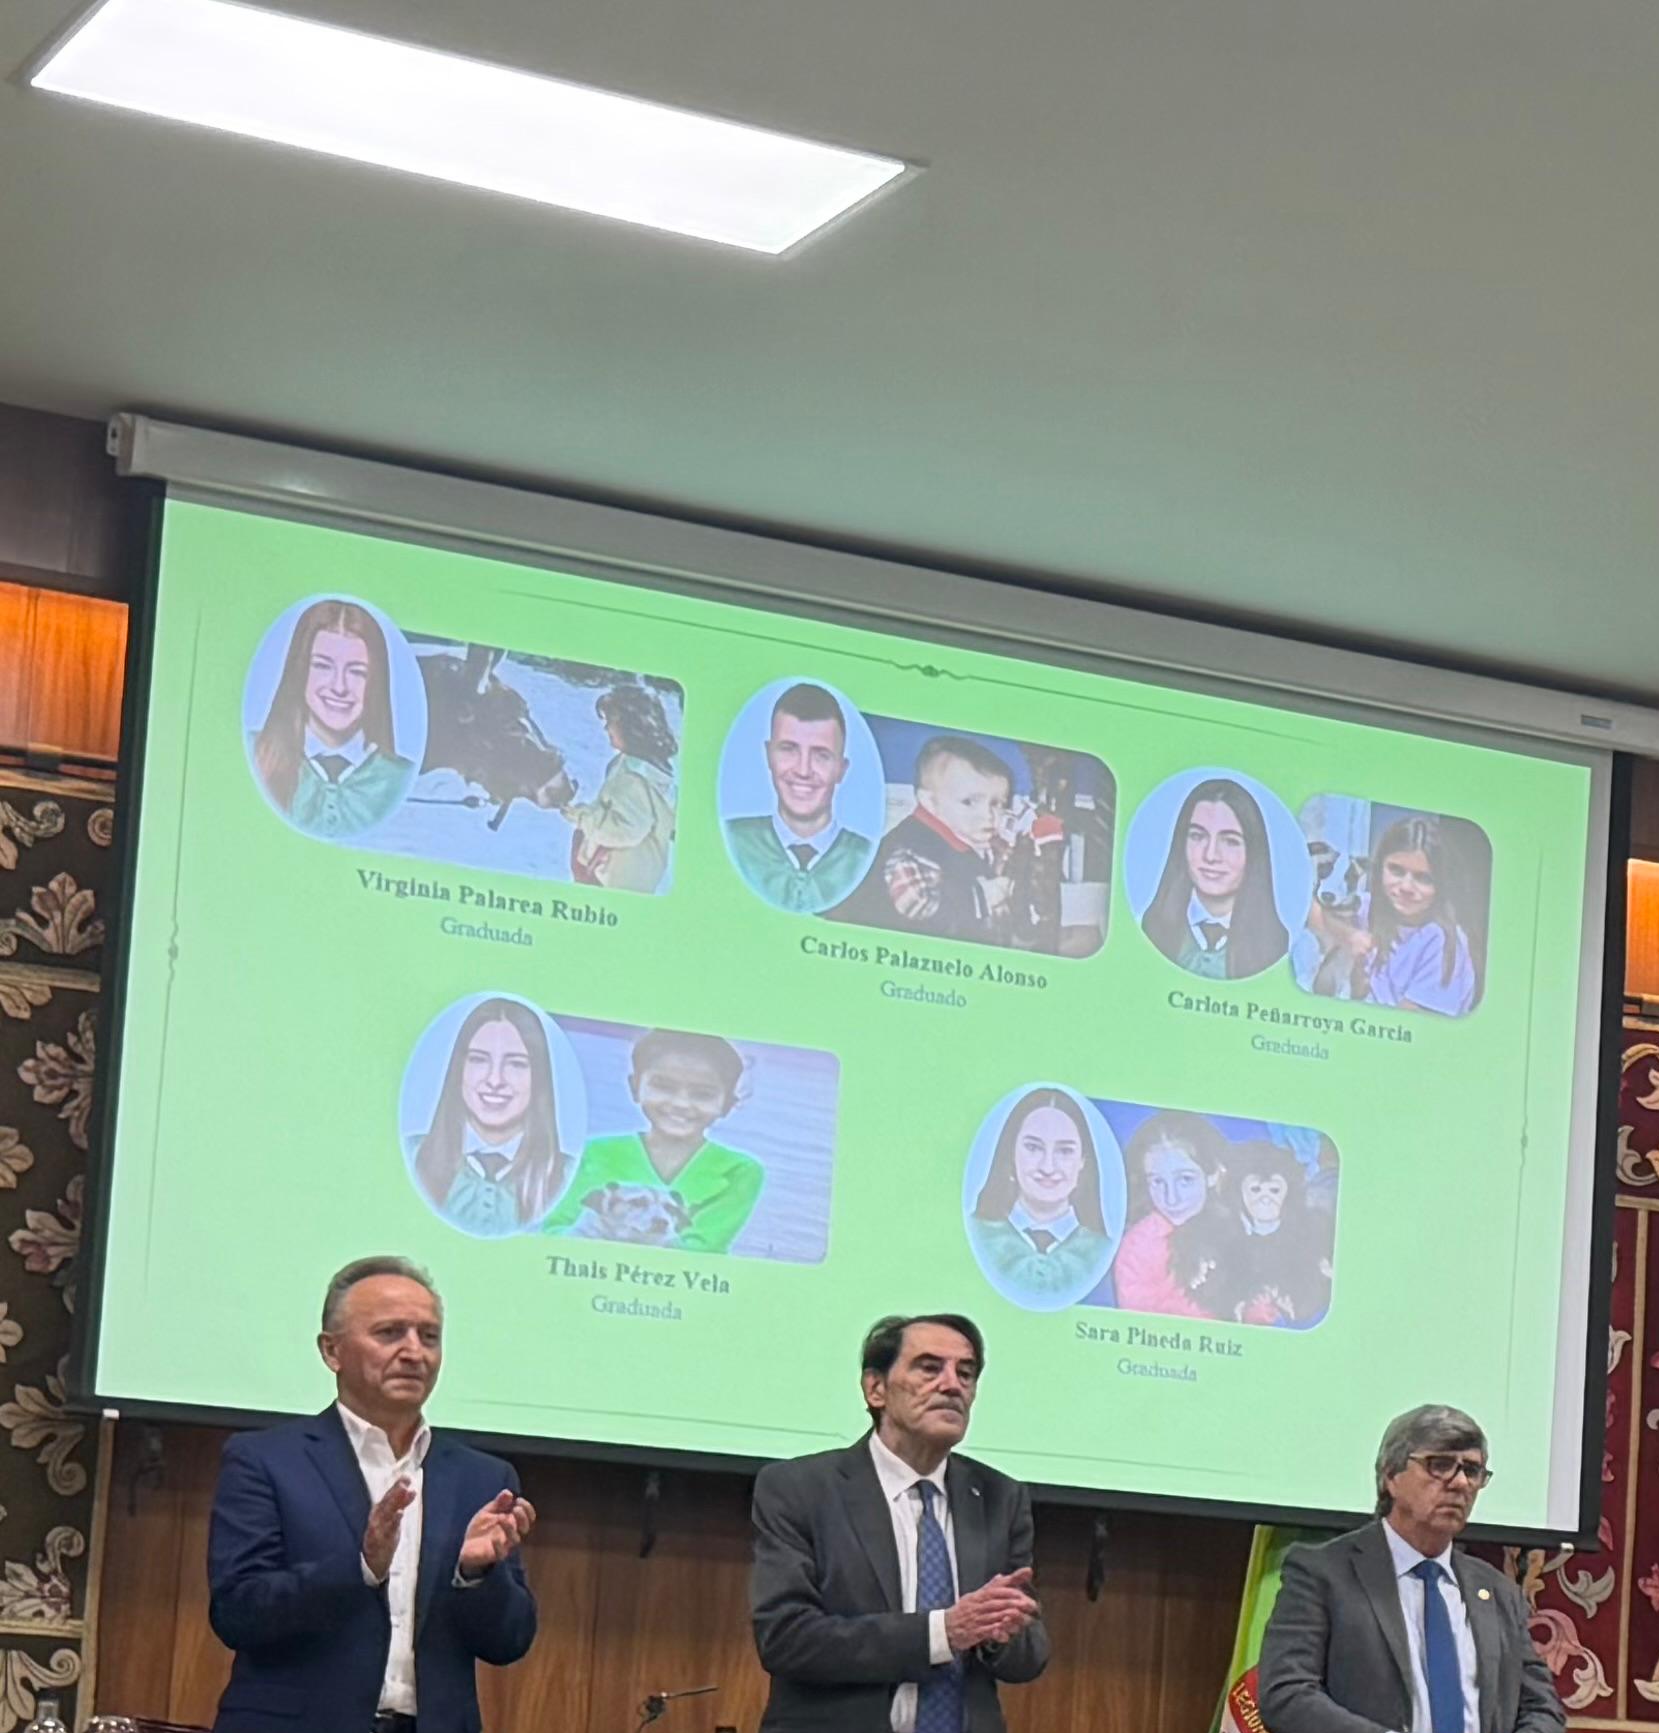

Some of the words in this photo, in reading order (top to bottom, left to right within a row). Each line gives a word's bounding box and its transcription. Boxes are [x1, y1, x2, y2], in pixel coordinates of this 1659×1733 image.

[357, 868, 451, 900] Virginia
[458, 885, 543, 916] Palarea
[551, 899, 618, 928] Rubio
[440, 916, 534, 946] Graduada
[800, 935, 869, 963] Carlos
[875, 946, 974, 979] Palazuelo
[979, 963, 1048, 990] Alonso
[880, 980, 967, 1008] Graduado
[1167, 990, 1239, 1018] Carlota
[1246, 1002, 1344, 1034] Peñarroya
[1251, 1034, 1330, 1060] Graduada
[615, 1262, 676, 1288] Pérez
[682, 1270, 730, 1294] Vela
[591, 1294, 682, 1320] Graduada
[1075, 1321, 1120, 1343] Sara
[1127, 1326, 1192, 1352] Pineda
[1199, 1335, 1243, 1357] Ruiz
[1116, 1357, 1198, 1382] Graduada
